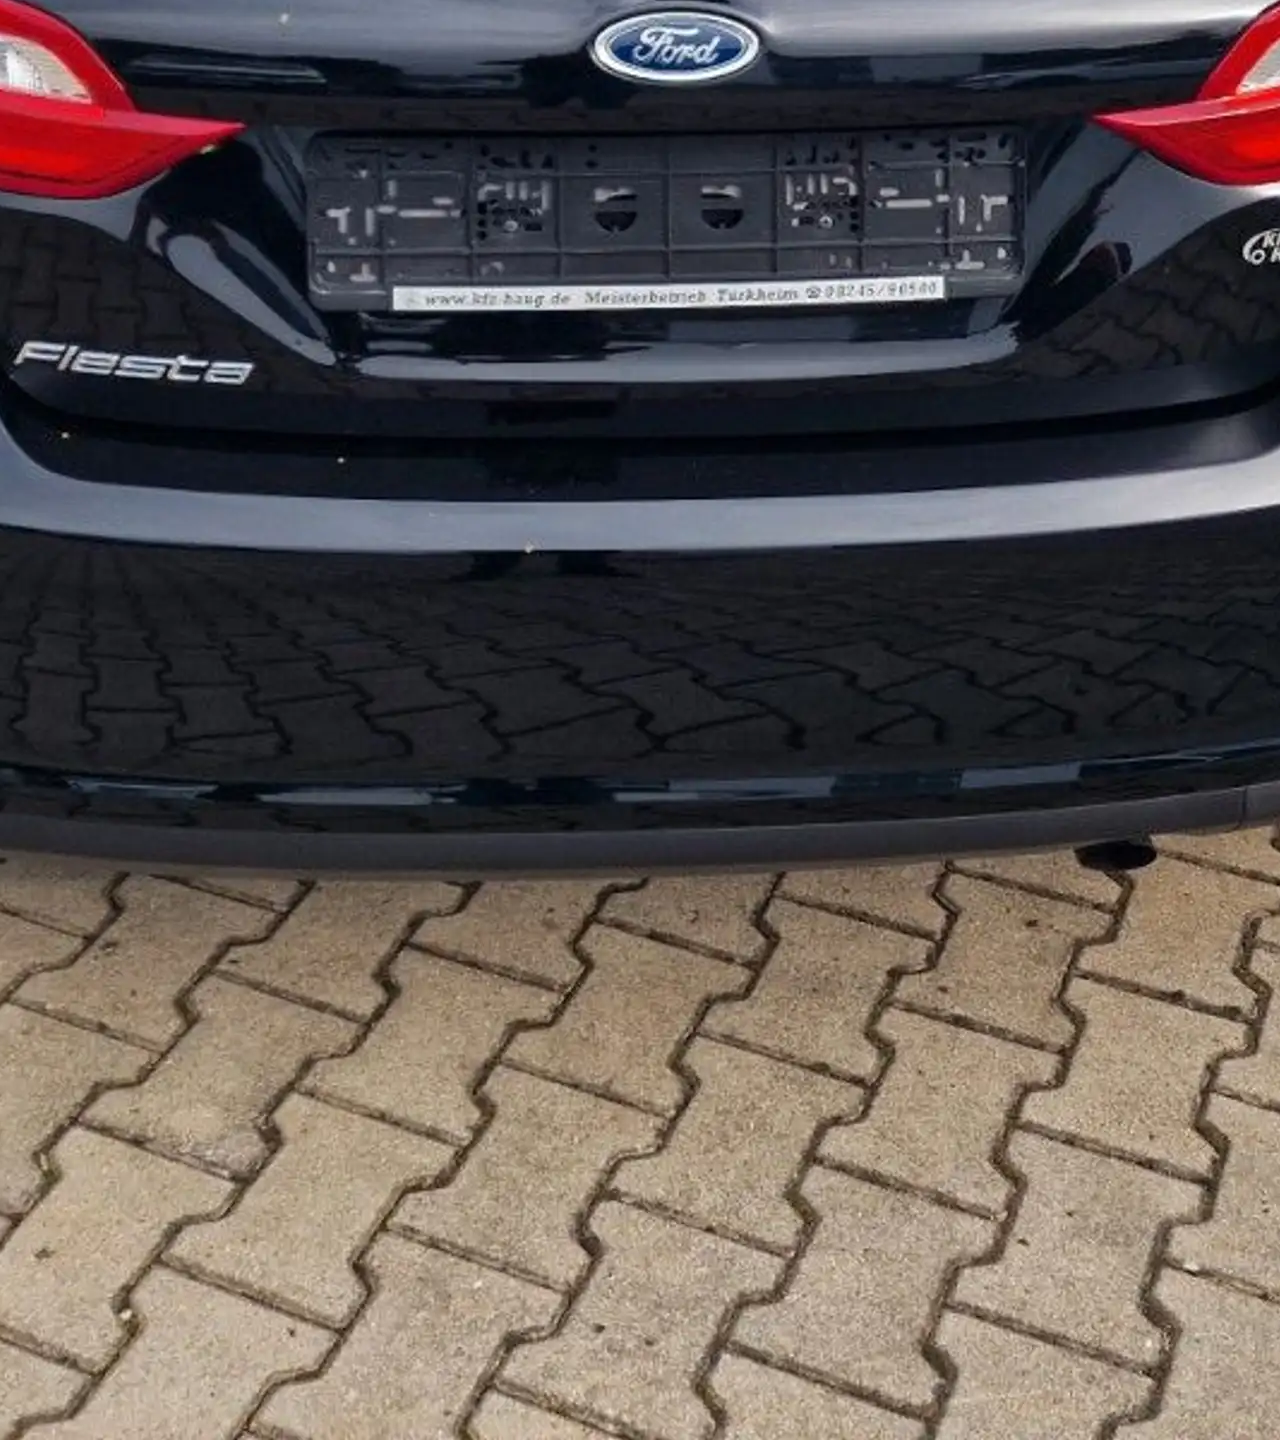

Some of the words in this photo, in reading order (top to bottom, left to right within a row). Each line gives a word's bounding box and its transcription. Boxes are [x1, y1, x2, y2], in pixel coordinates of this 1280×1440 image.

[632, 26, 721, 64] Ford
[584, 287, 707, 305] Meisterbetrieb
[14, 340, 254, 385] Fiesta
